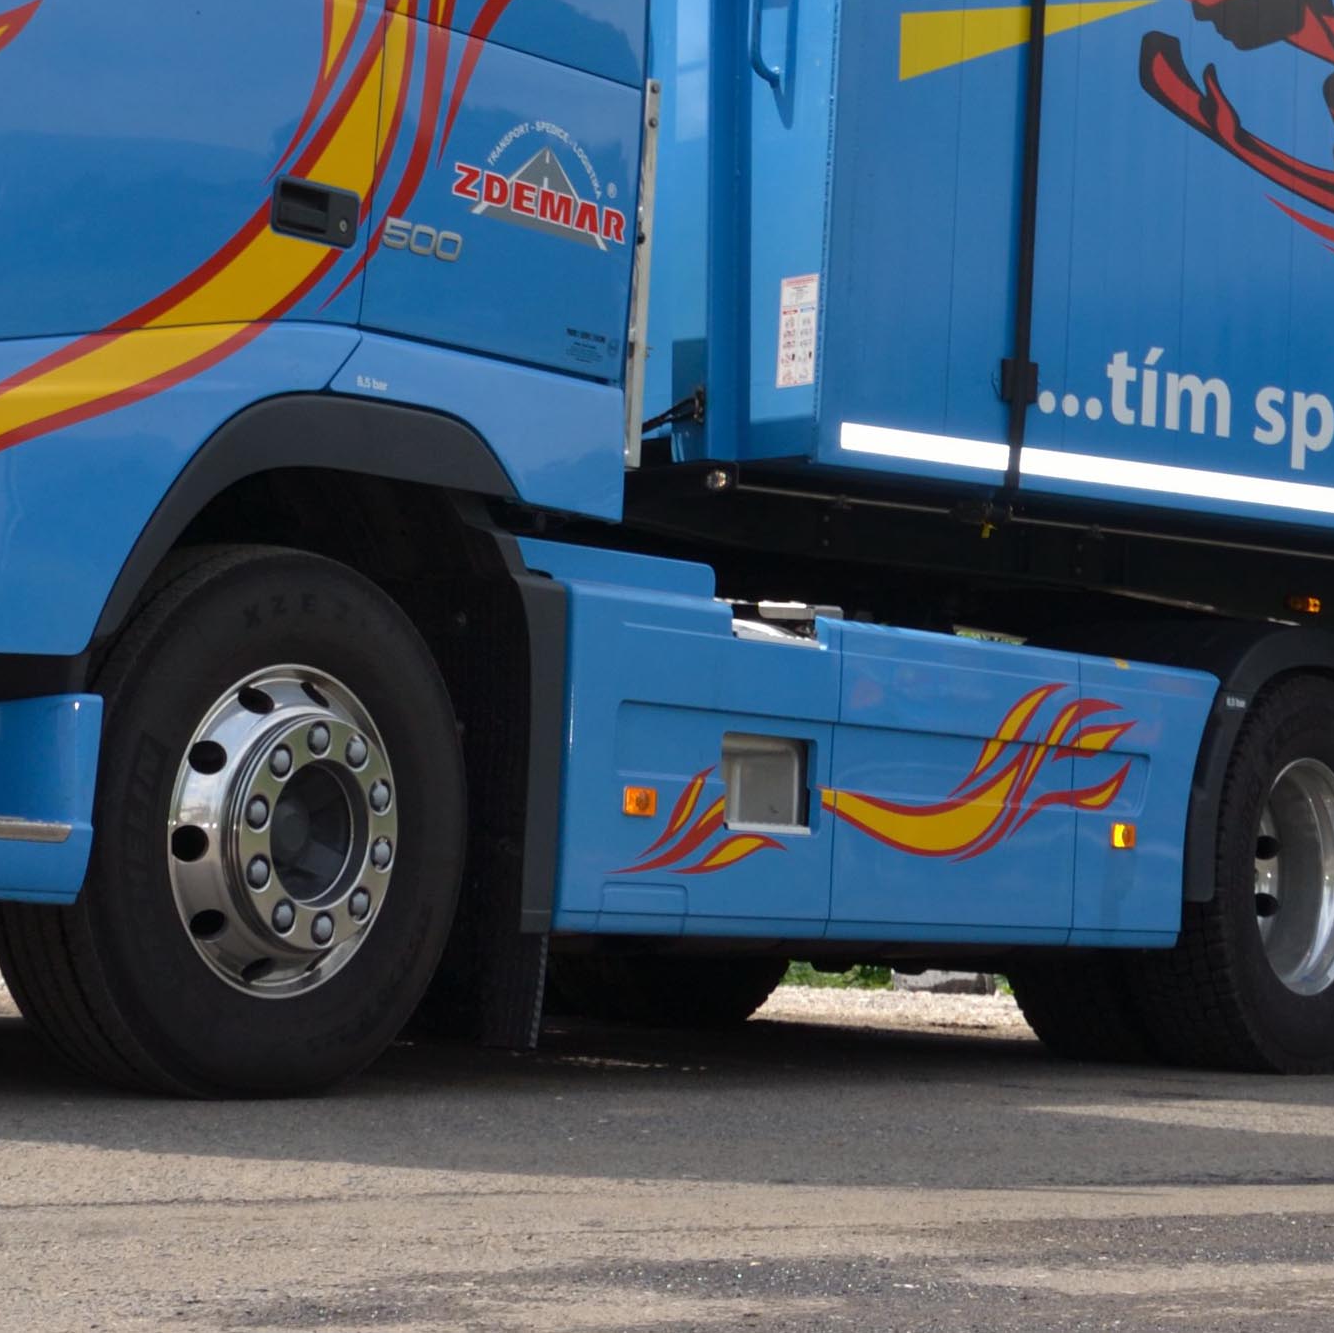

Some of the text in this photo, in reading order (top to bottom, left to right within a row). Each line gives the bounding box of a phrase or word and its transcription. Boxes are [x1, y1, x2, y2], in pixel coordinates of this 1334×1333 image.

[487, 122, 529, 166] TRANSPORT
[452, 162, 626, 245] ZDEMAR
[383, 217, 463, 263] 500
